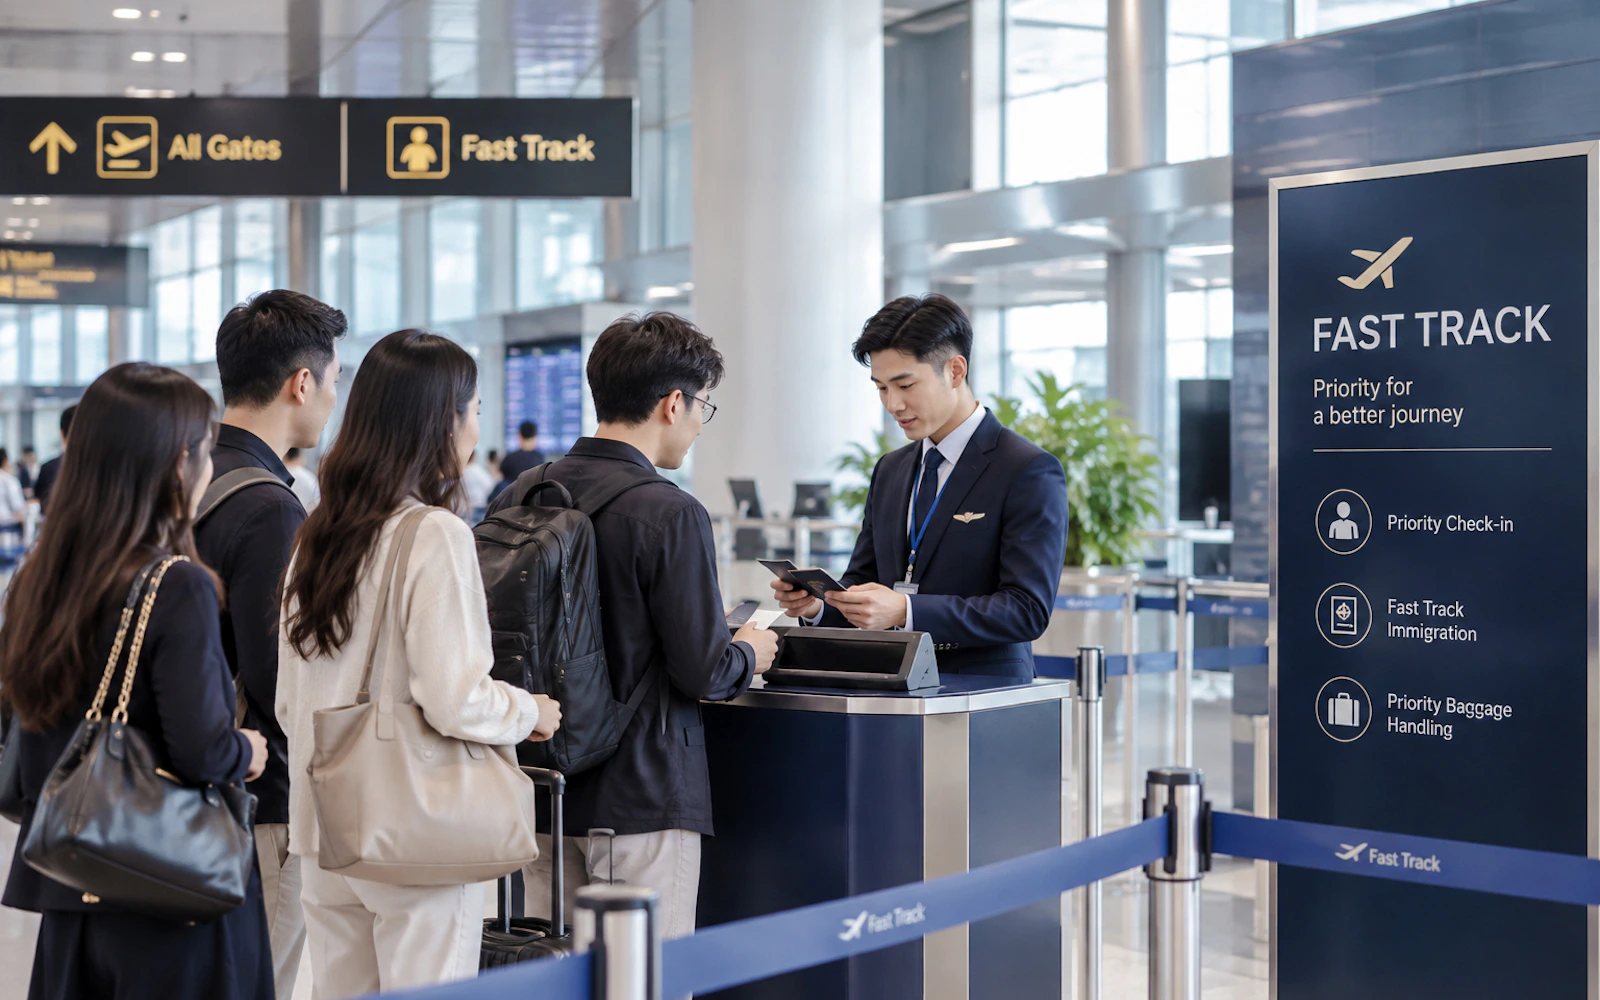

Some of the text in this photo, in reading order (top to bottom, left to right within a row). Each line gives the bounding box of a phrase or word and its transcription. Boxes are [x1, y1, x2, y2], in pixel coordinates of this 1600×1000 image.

[167, 132, 282, 161] All Gates
[461, 133, 596, 162] Fast Track
[1313, 304, 1552, 352] FAST TRACK
[1313, 375, 1414, 402] Priority for
[1313, 403, 1464, 429] a better journey
[1387, 514, 1514, 535] Priority Check-in
[1387, 598, 1465, 618] Fast Track
[1387, 621, 1477, 644] Immigration
[1387, 692, 1513, 721] Priority Baggage
[1387, 716, 1453, 741] Handling
[1368, 848, 1441, 872] Fast Track
[867, 901, 926, 934] Fast Track
